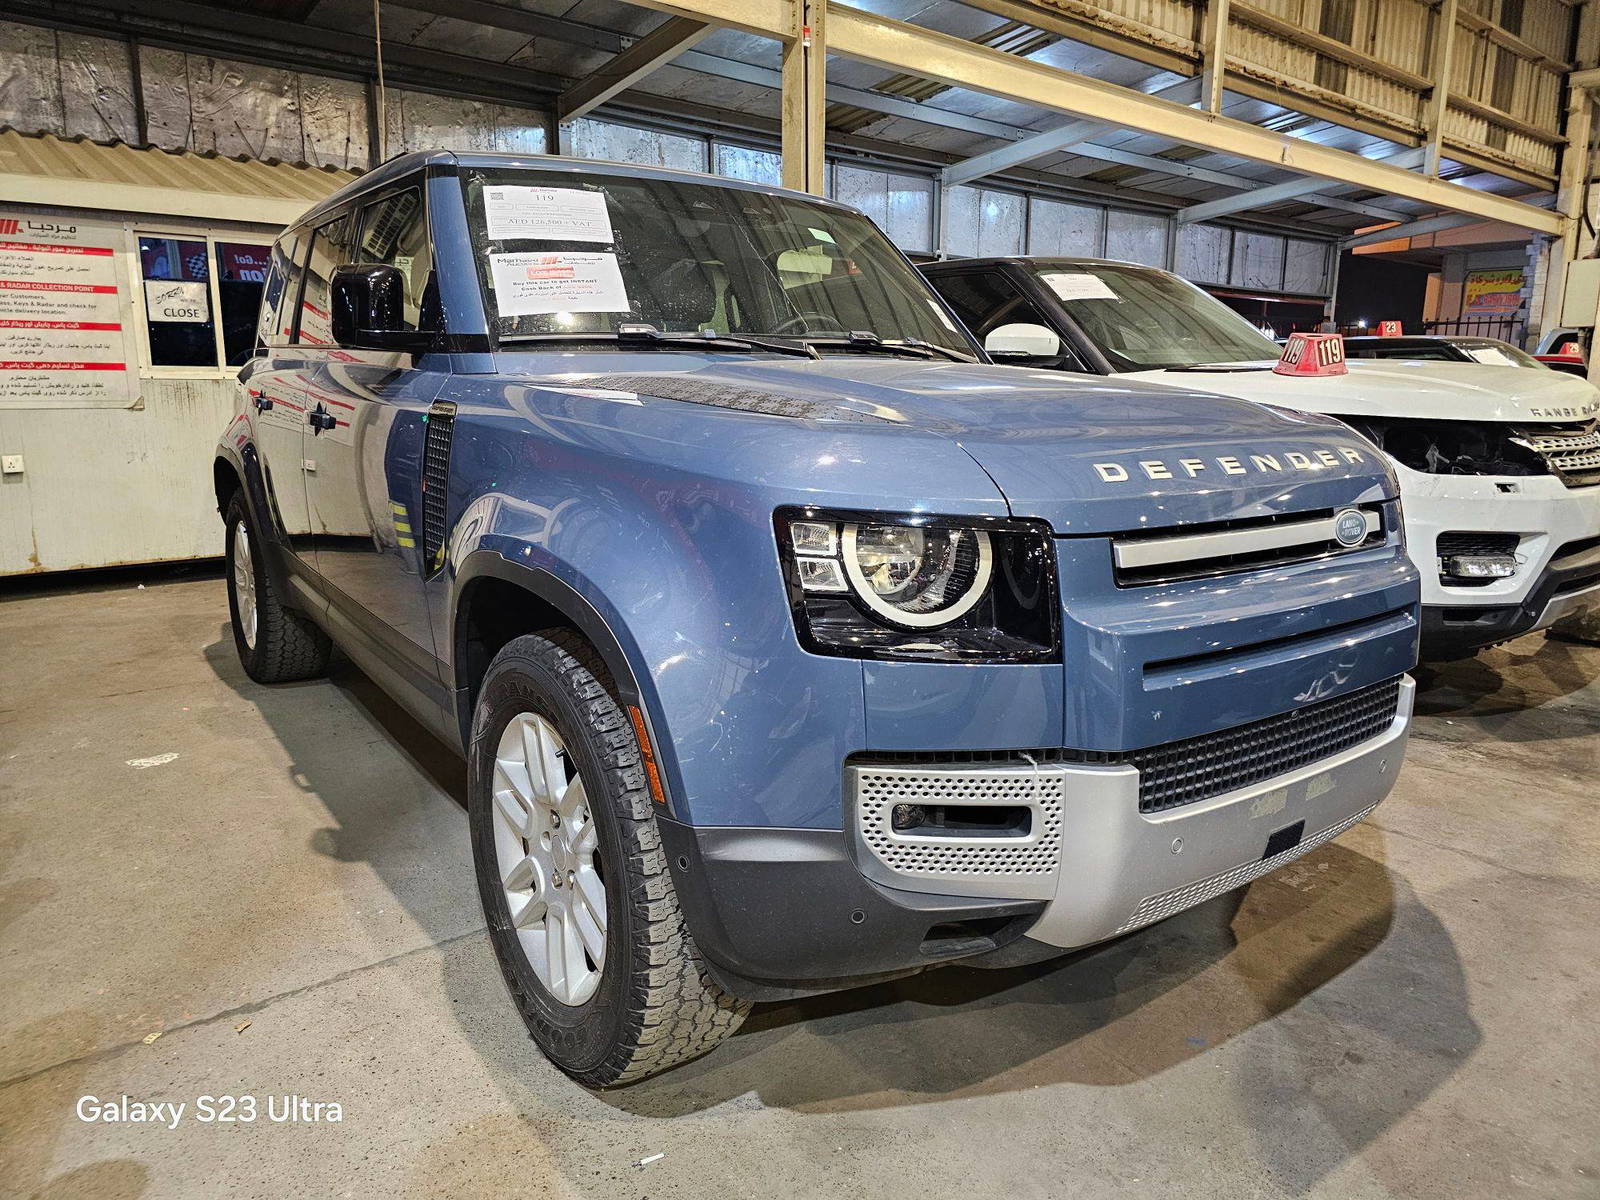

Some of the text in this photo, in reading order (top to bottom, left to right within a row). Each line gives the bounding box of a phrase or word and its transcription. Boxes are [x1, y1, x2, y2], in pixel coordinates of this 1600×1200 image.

[28, 220, 77, 233] مرحبا
[7, 282, 31, 290] RADAR
[32, 283, 74, 291] COLLECTION
[163, 307, 200, 318] CLOSE
[1386, 321, 1397, 333] 23
[1319, 338, 1342, 367] 119
[1530, 407, 1578, 417] RANGE
[1093, 447, 1365, 483] DEFENDER
[1342, 519, 1357, 529] LAND
[1344, 526, 1361, 537] ROVER
